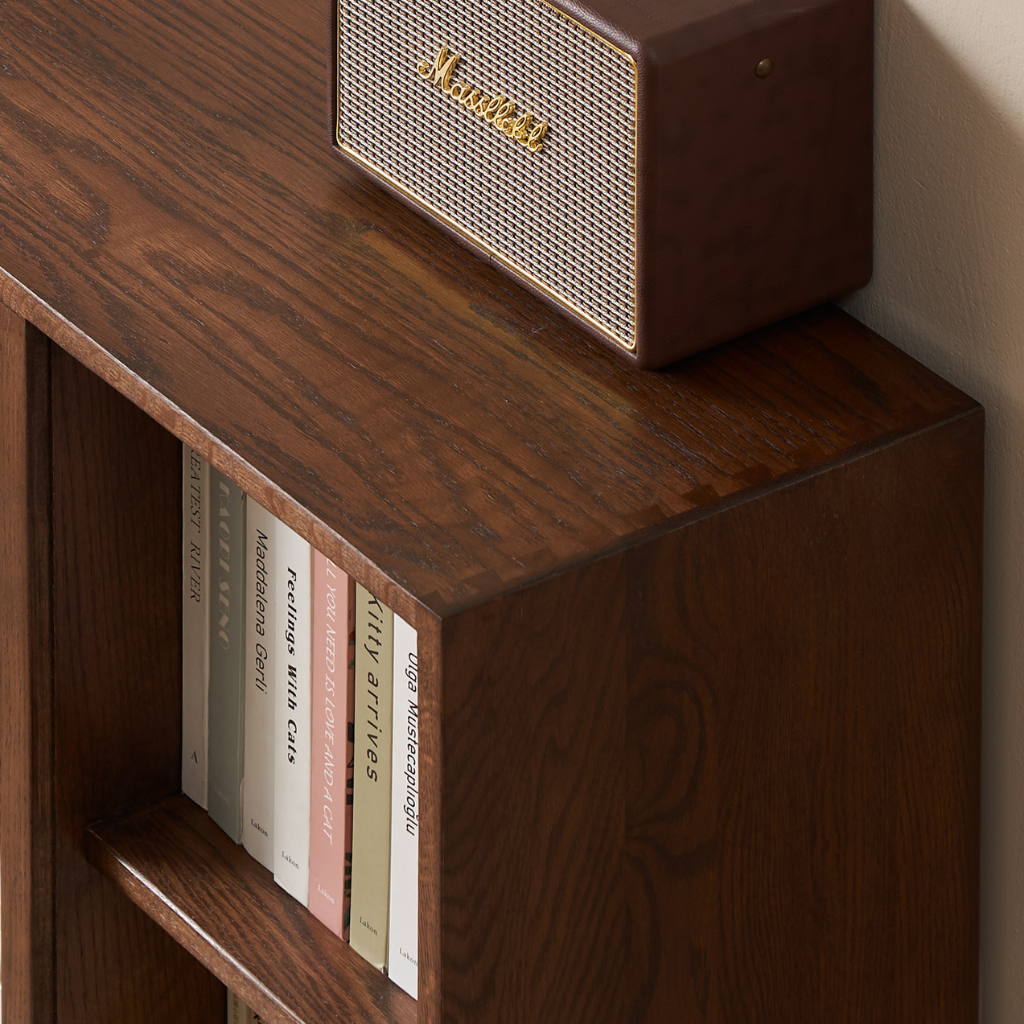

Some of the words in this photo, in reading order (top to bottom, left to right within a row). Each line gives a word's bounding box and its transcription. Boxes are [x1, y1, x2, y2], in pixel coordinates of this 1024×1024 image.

[190, 449, 201, 534] EATEST
[219, 480, 230, 573] KAORI
[189, 541, 201, 604] RIVER
[255, 528, 268, 637] Maddalena
[218, 576, 230, 650] SENO
[285, 566, 297, 656] Feelings
[326, 582, 336, 623] YOU
[255, 643, 268, 695] Gerli
[325, 623, 337, 673] NEED
[287, 664, 298, 711] With
[324, 673, 336, 697] IS
[287, 718, 298, 765] Cats
[324, 697, 336, 745] LOVE
[366, 671, 382, 783] arrives
[323, 744, 335, 786] AND
[323, 786, 334, 803] A
[250, 818, 269, 838] Lakon
[322, 804, 333, 845] CAT
[281, 850, 300, 870] Lakon
[317, 884, 335, 904] Lakon
[359, 916, 378, 936] Lakon
[399, 947, 418, 967] Lakon
